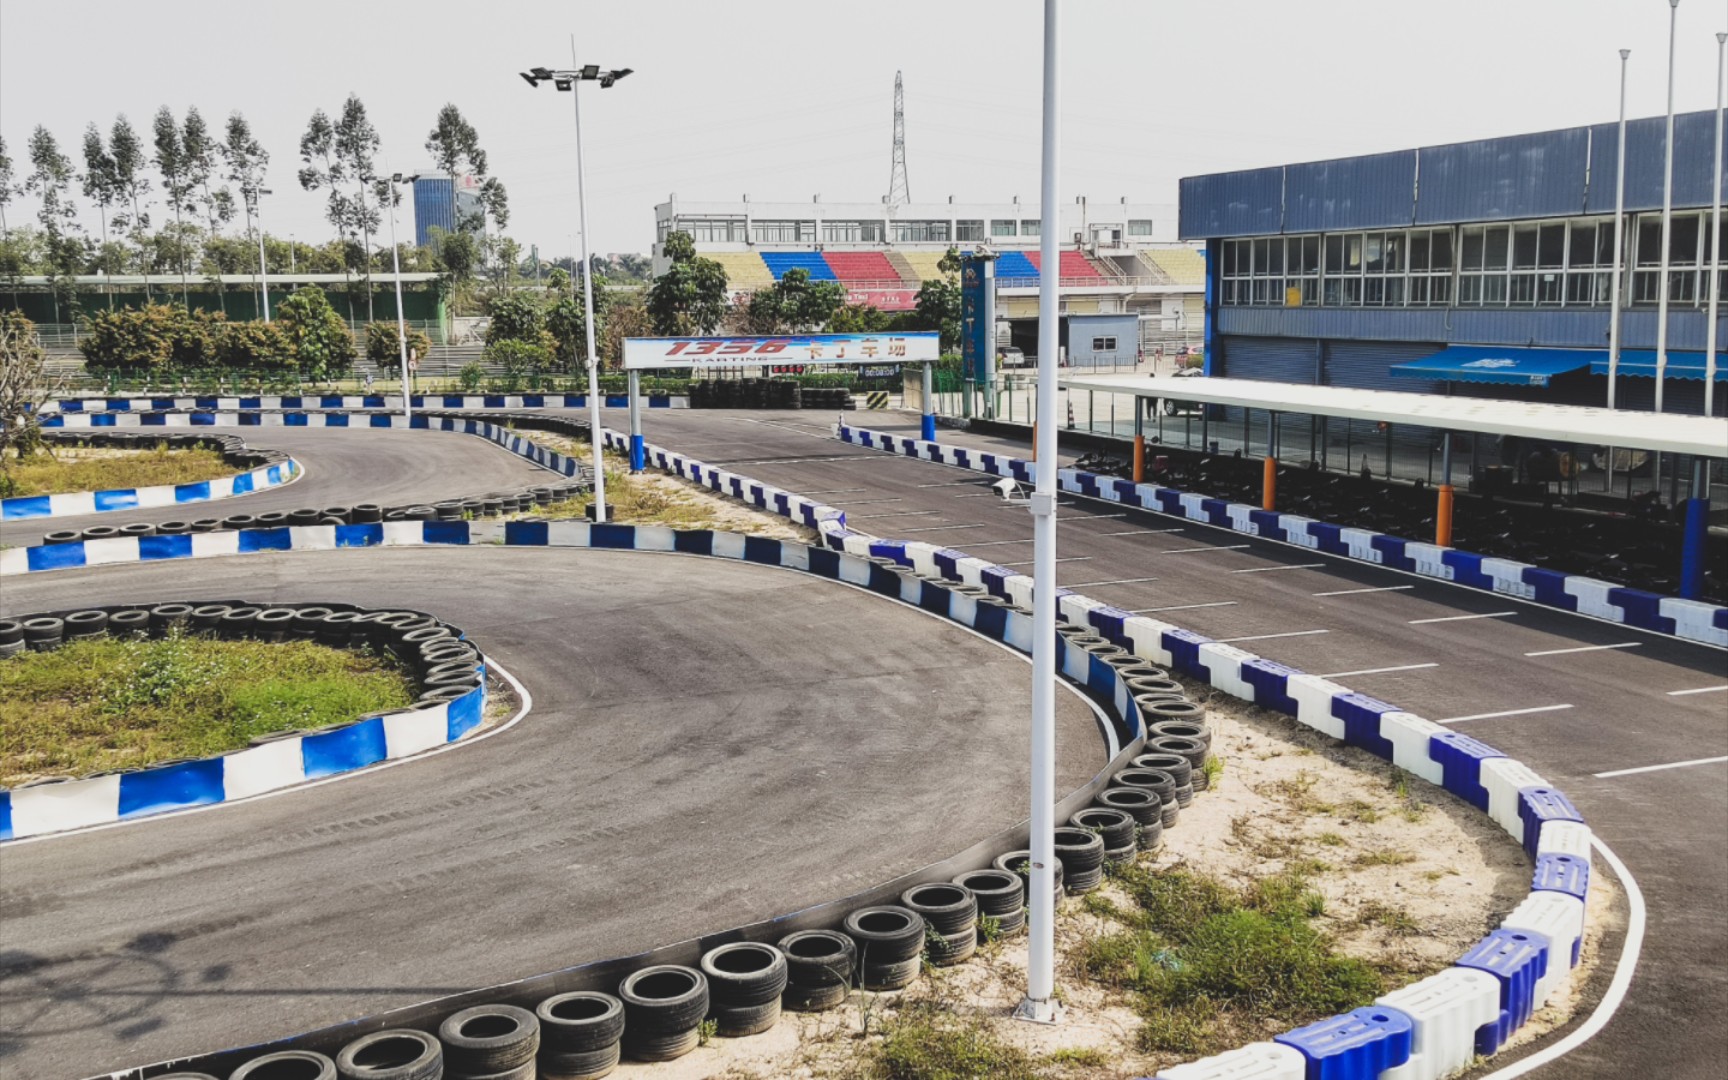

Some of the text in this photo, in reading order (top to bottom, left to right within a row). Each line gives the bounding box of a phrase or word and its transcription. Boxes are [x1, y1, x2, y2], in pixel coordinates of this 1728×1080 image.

[665, 337, 906, 360] 1356 卡丁车场
